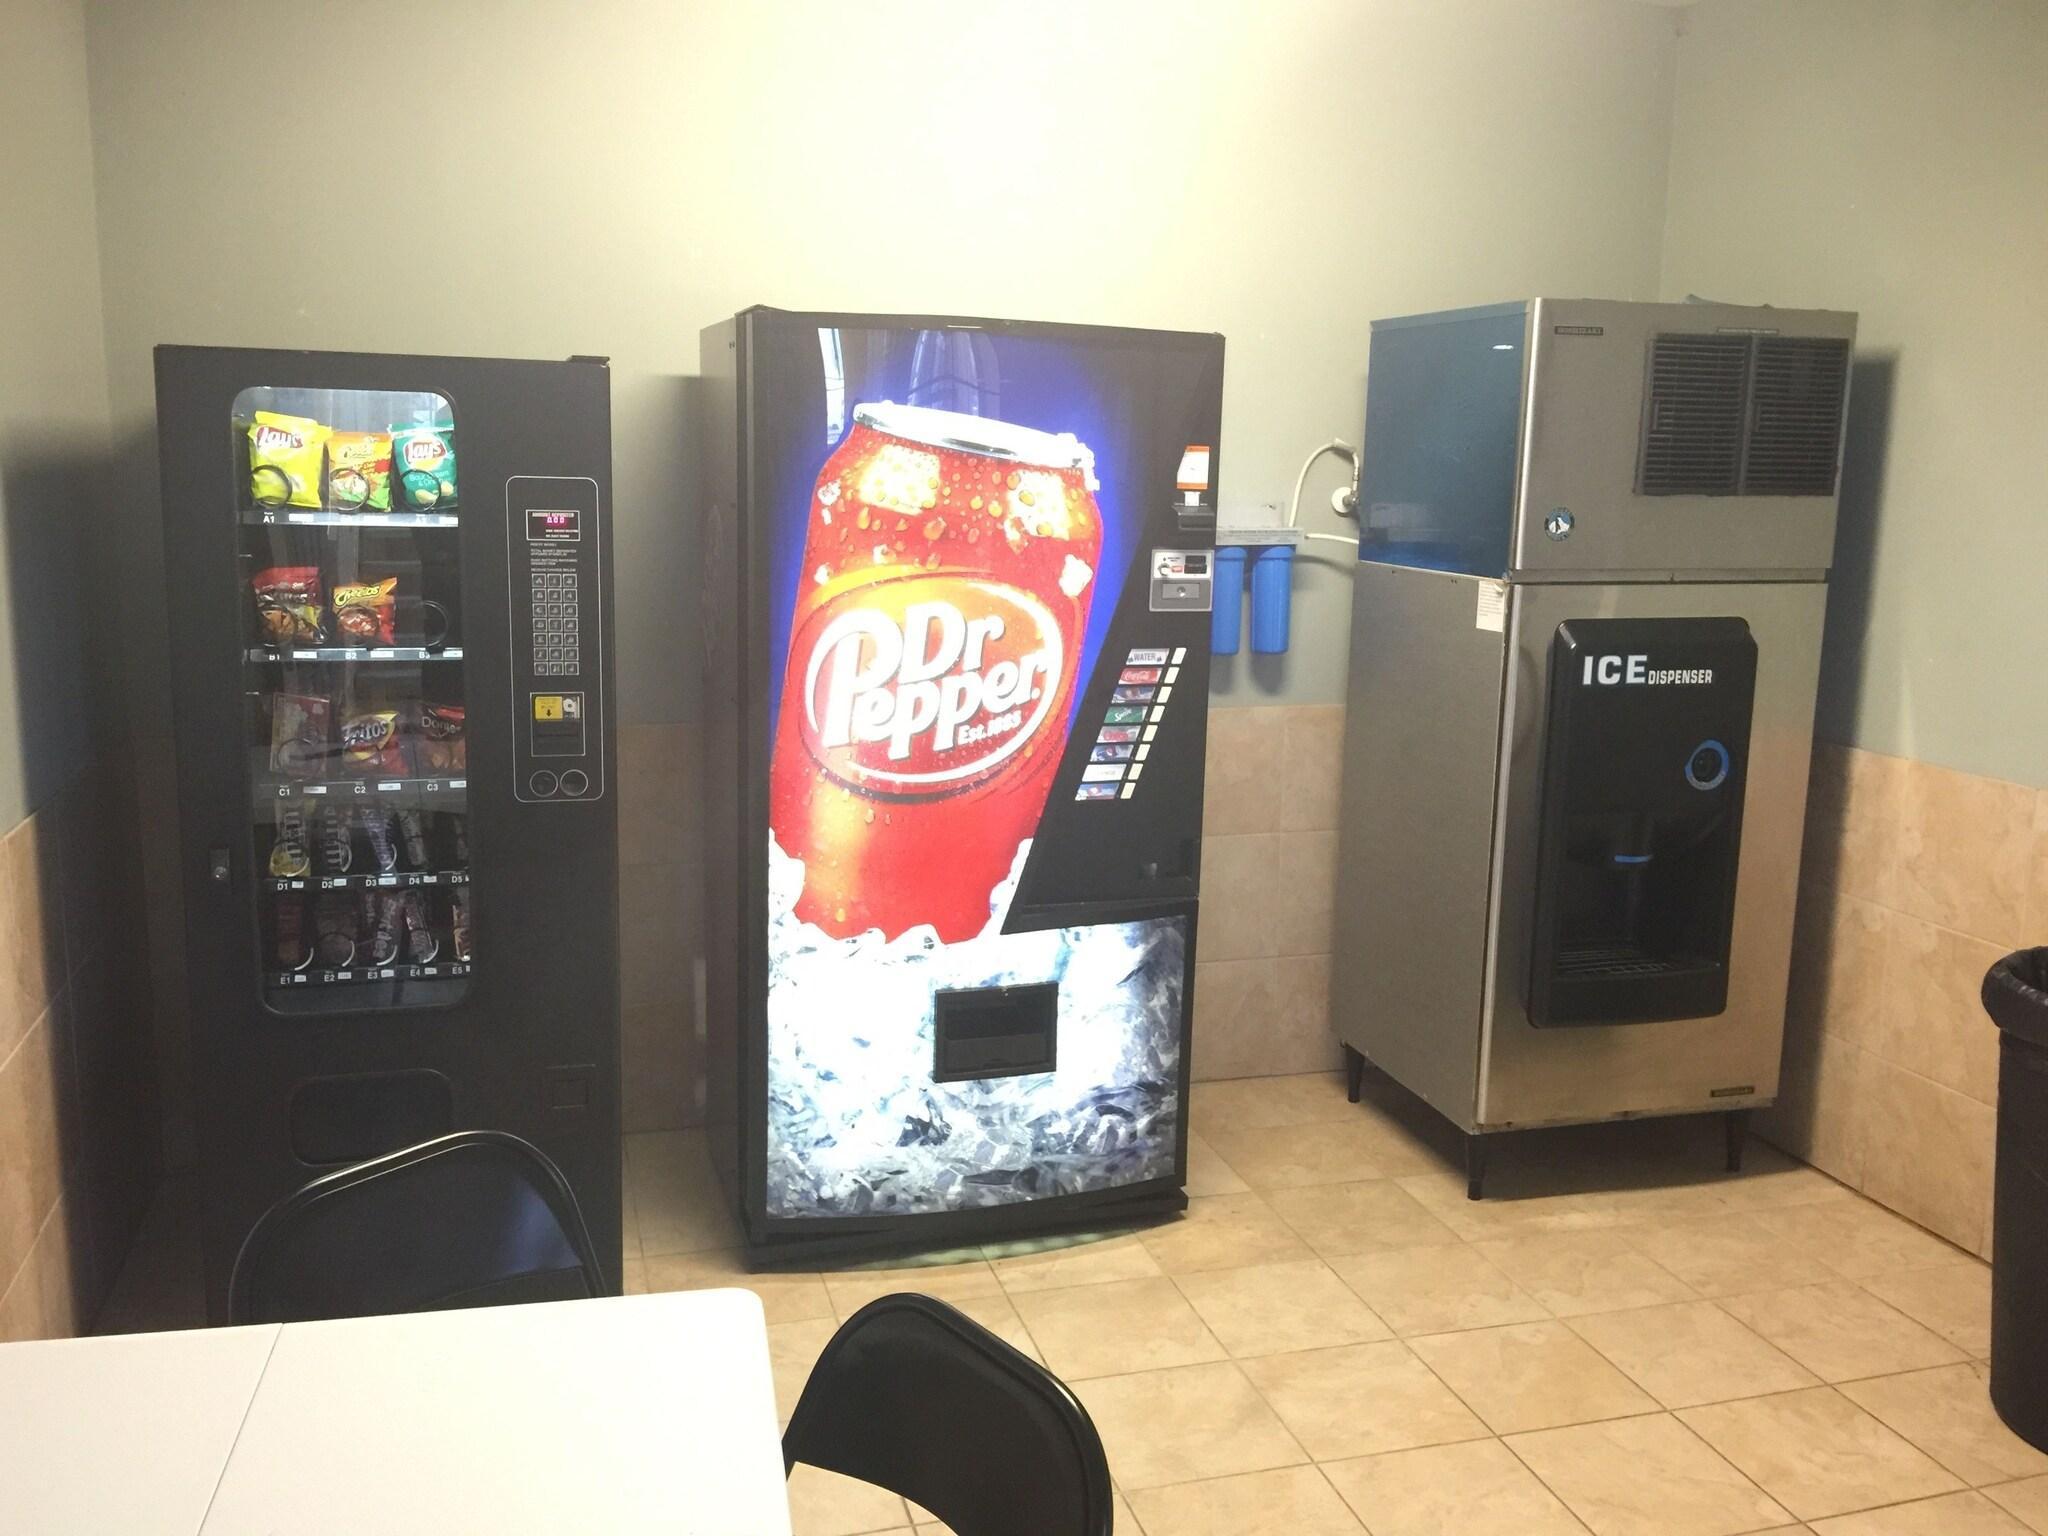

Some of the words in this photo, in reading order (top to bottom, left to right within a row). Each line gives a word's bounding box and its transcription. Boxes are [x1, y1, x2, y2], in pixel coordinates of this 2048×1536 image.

[899, 601, 1005, 685] Dr
[345, 652, 357, 660] B2
[1134, 653, 1156, 661] WATER
[1582, 655, 1648, 685] ICE
[1647, 669, 1713, 685] DISPENSER
[805, 607, 1048, 760] Pepper
[279, 787, 290, 796] C1
[354, 785, 366, 794] C2
[427, 783, 439, 792] C3
[365, 879, 377, 887] D3
[409, 877, 420, 885] D4
[451, 875, 463, 883] D5
[277, 882, 288, 891] D1
[321, 880, 333, 888] D2
[324, 974, 335, 982] E2
[367, 971, 378, 979] E3
